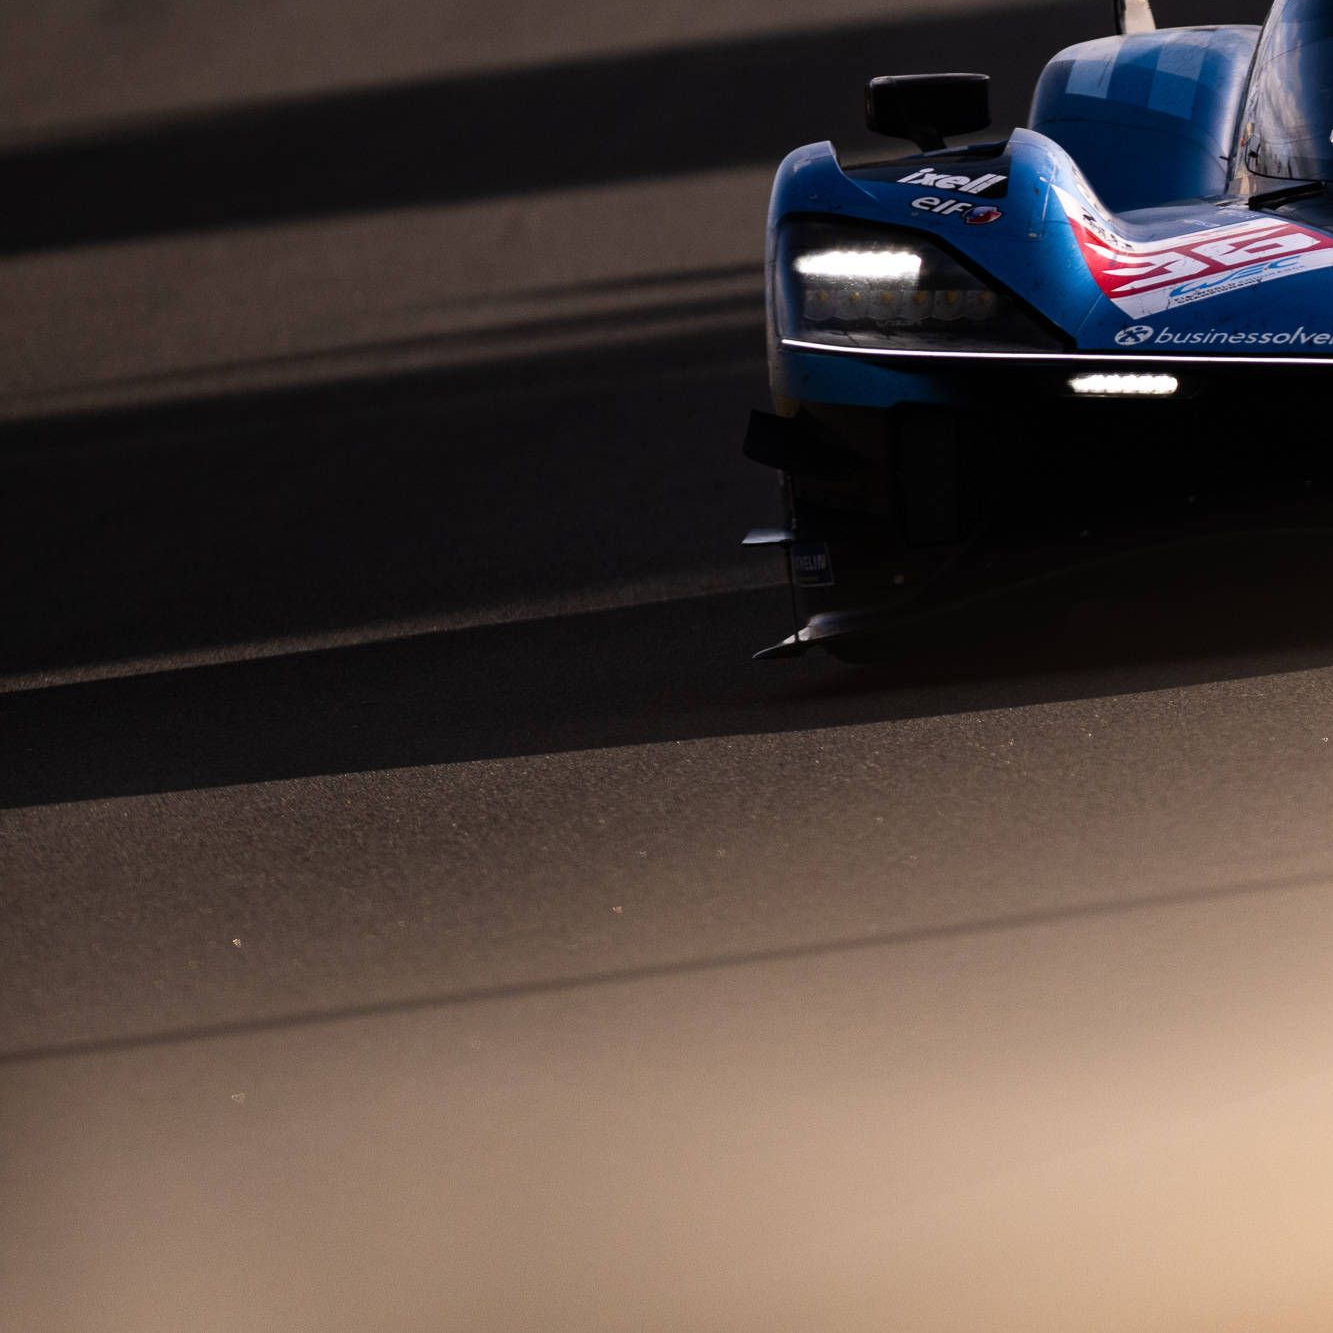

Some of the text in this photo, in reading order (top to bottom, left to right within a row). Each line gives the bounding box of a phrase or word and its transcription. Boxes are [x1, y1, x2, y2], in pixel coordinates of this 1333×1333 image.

[896, 167, 1008, 195] ixell
[911, 197, 973, 215] elf
[1085, 223, 1321, 293] 36
